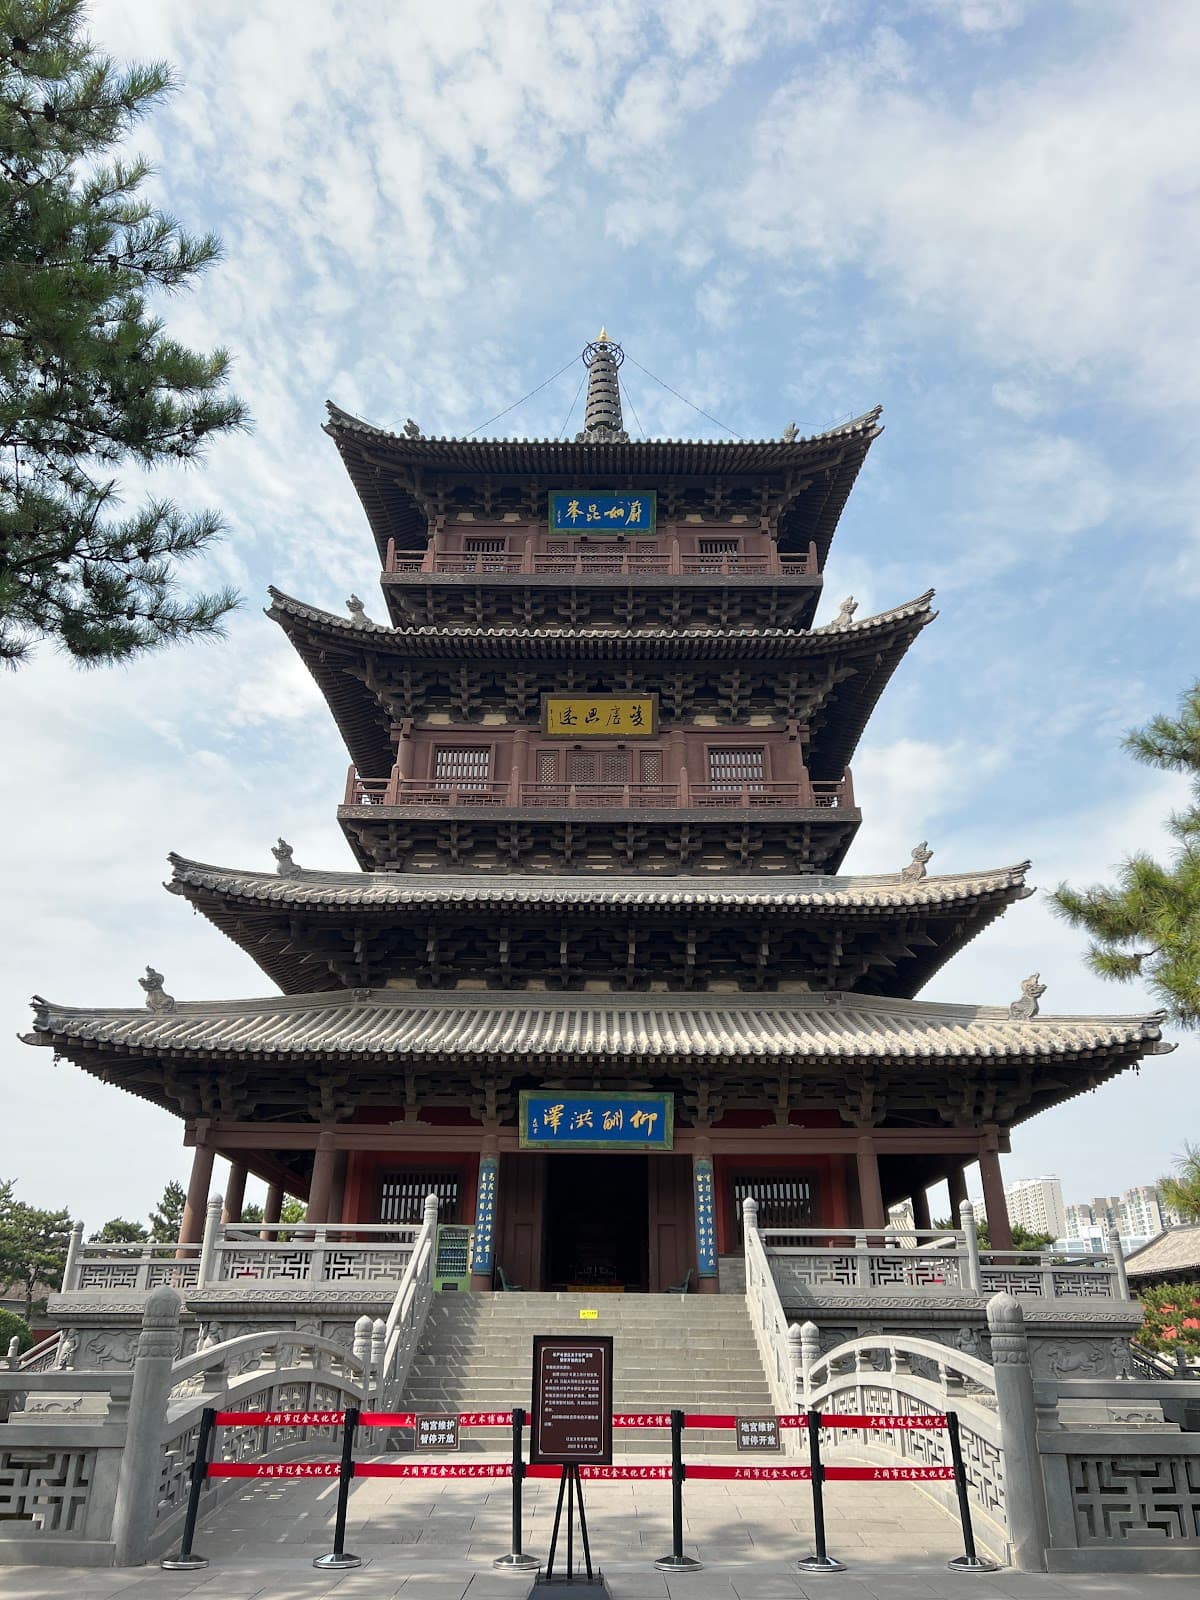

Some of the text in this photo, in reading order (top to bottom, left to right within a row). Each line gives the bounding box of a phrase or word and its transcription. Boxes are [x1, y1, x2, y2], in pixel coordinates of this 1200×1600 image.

[421, 1420, 455, 1431] 地宫维护
[741, 1421, 775, 1432] 地宫维护
[420, 1433, 455, 1444] 暂停开放
[741, 1435, 776, 1446] 暂停开放
